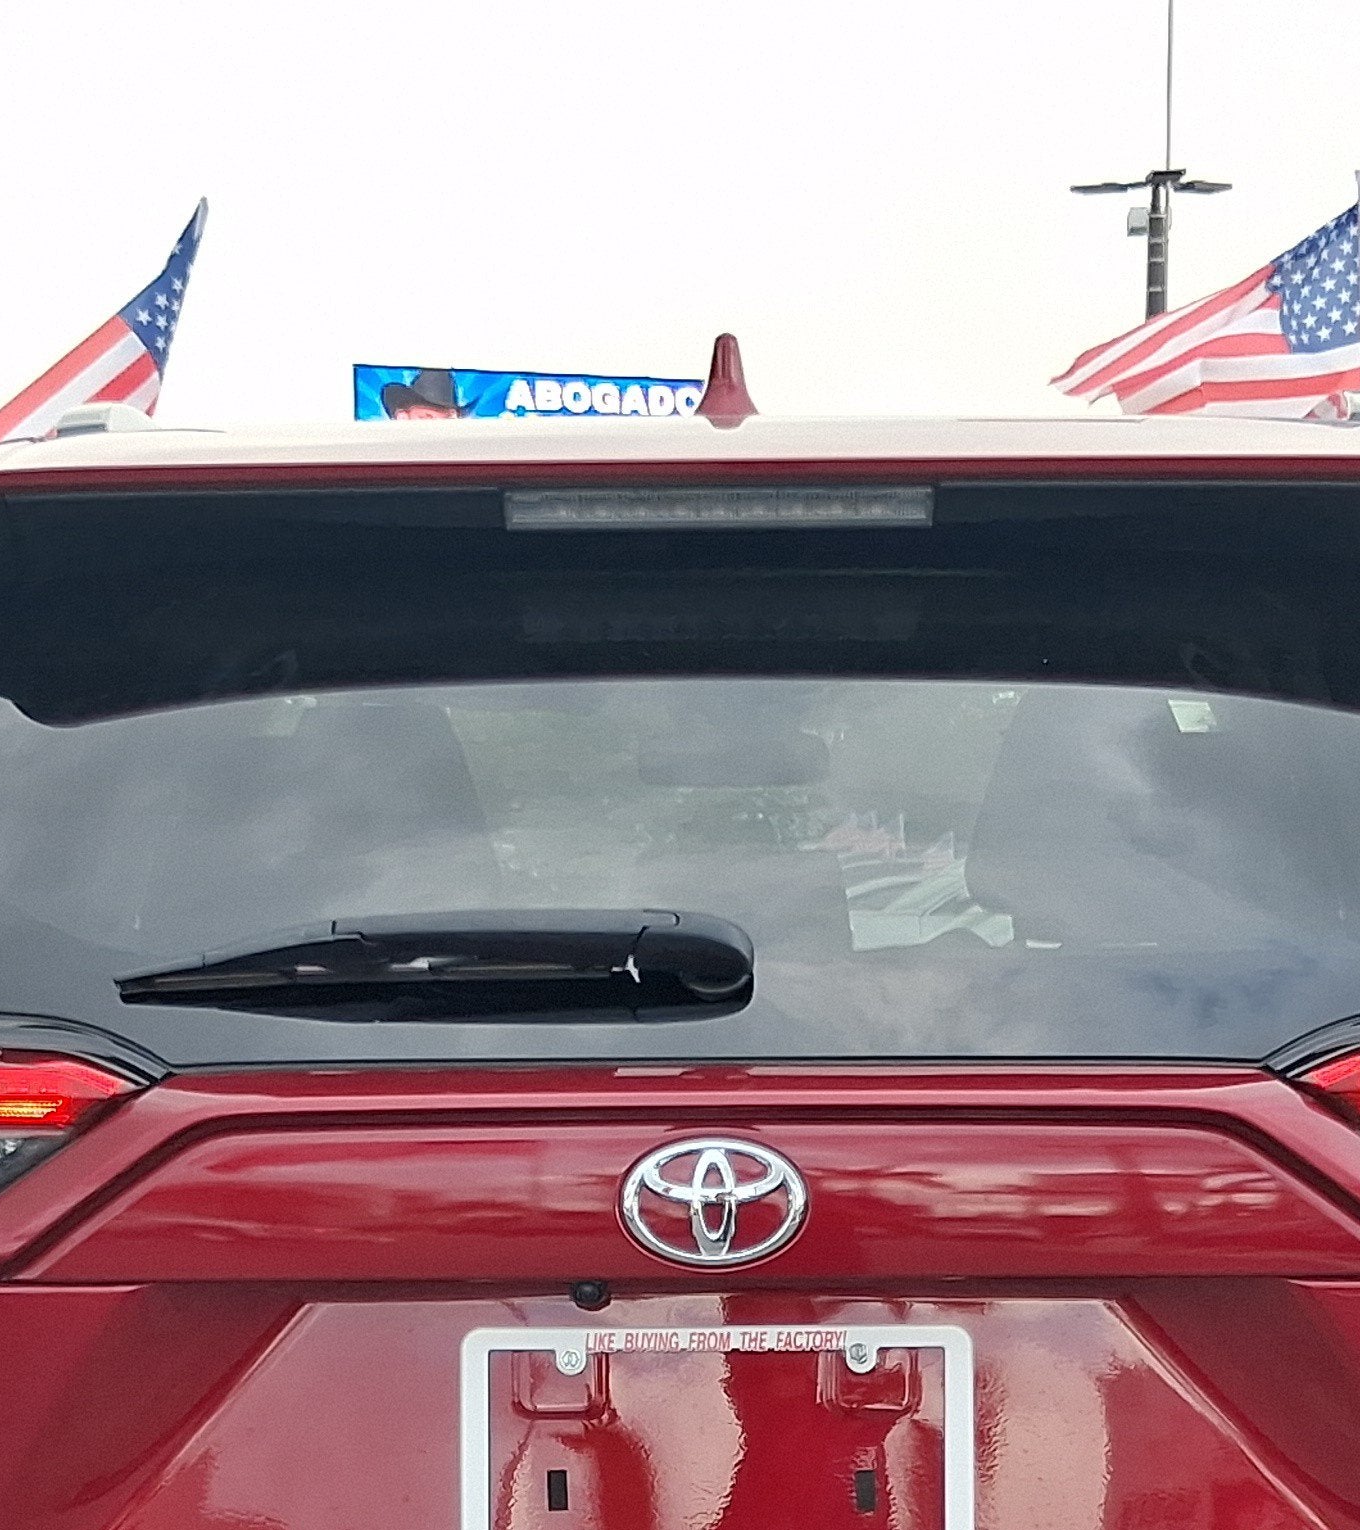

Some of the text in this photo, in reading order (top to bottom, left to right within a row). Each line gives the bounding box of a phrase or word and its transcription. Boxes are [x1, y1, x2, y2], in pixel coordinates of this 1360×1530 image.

[505, 378, 703, 418] ABOGADO
[585, 1331, 848, 1351] LIKE BUYING FROM THE FACTORY!
